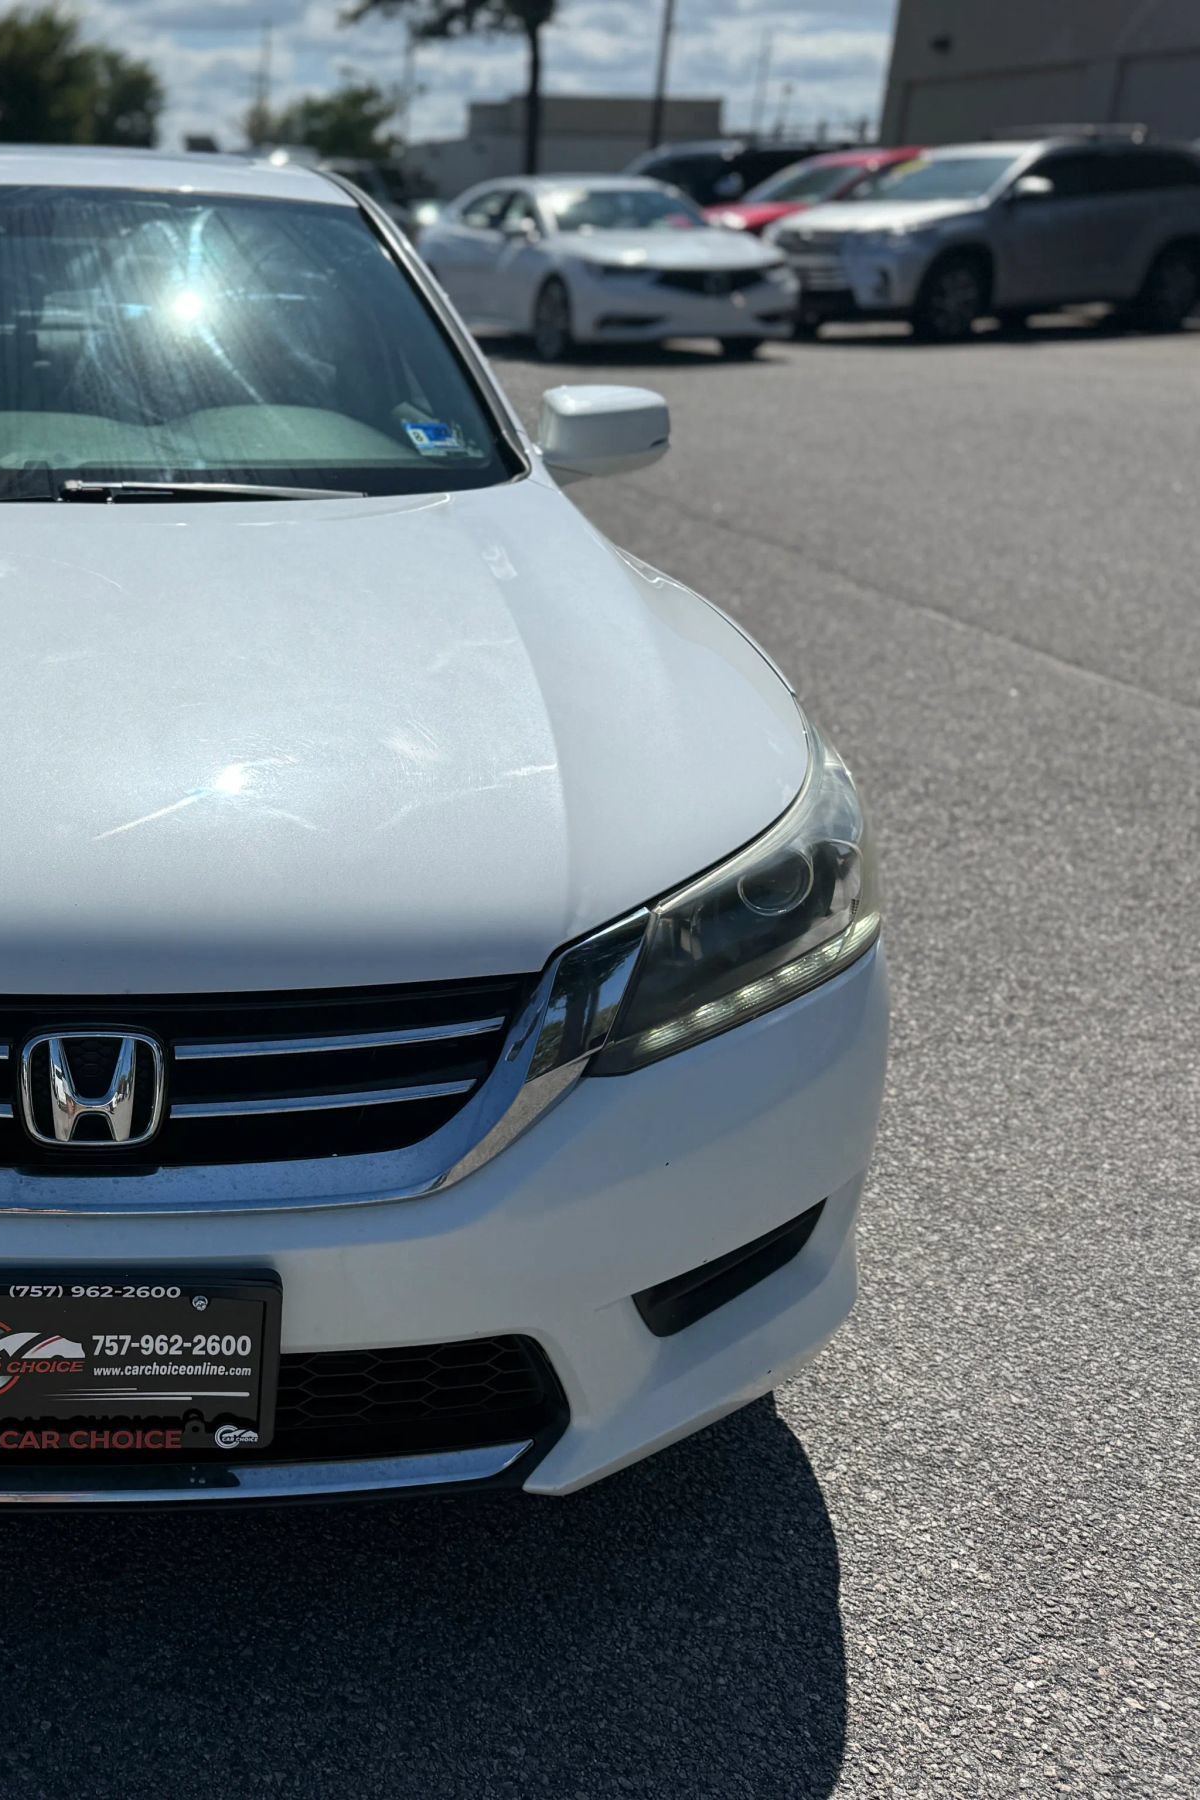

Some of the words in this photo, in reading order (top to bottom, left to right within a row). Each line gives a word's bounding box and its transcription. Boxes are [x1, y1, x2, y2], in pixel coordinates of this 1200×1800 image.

[9, 1285, 64, 1298] (757)
[71, 1285, 182, 1298] 962-2600
[92, 1334, 252, 1356] 757-962-2600
[6, 1360, 86, 1373] CHOICE
[93, 1361, 252, 1376] www.carchoiceonline.com
[0, 1429, 61, 1449] CAR
[68, 1429, 183, 1449] CHOICE
